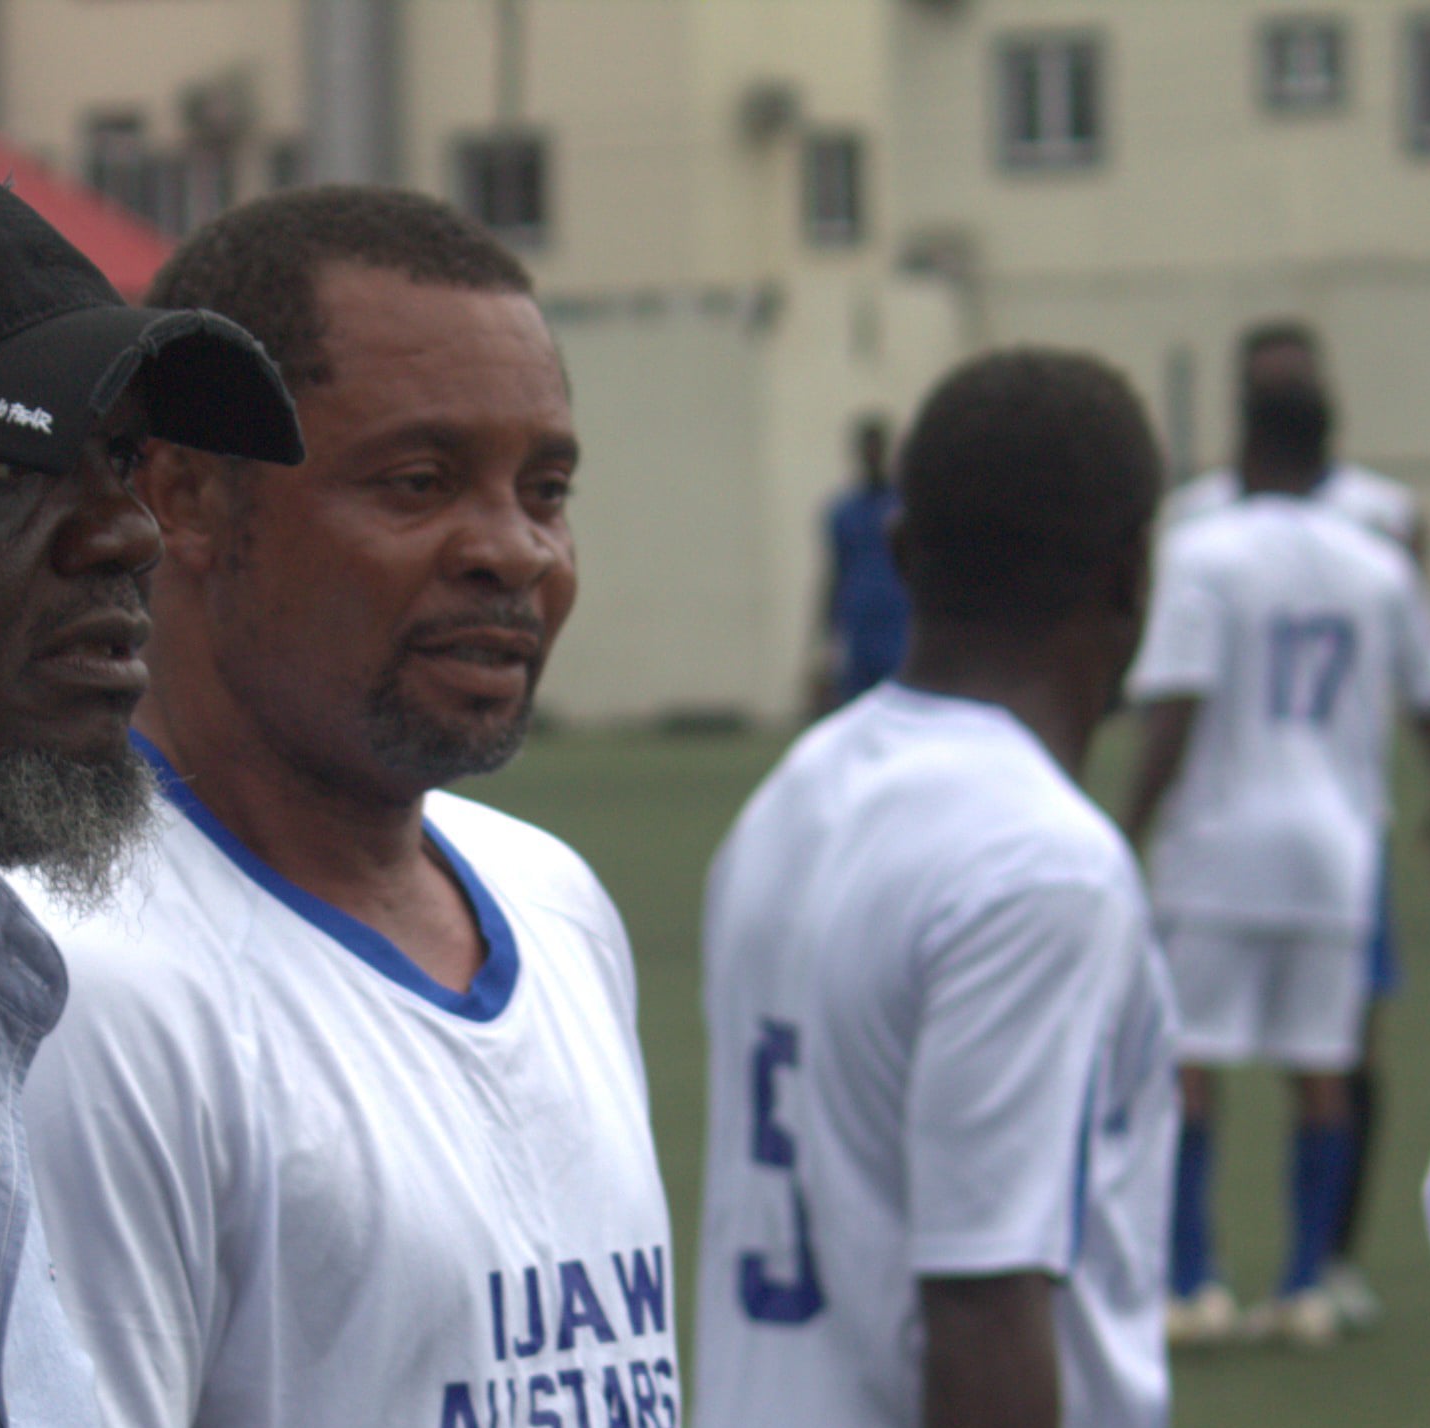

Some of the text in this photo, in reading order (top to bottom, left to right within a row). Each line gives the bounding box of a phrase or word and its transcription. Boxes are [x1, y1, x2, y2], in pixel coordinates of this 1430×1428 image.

[1268, 613, 1356, 724] 17
[739, 1014, 826, 1325] 5
[489, 1246, 666, 1361] IJAW
